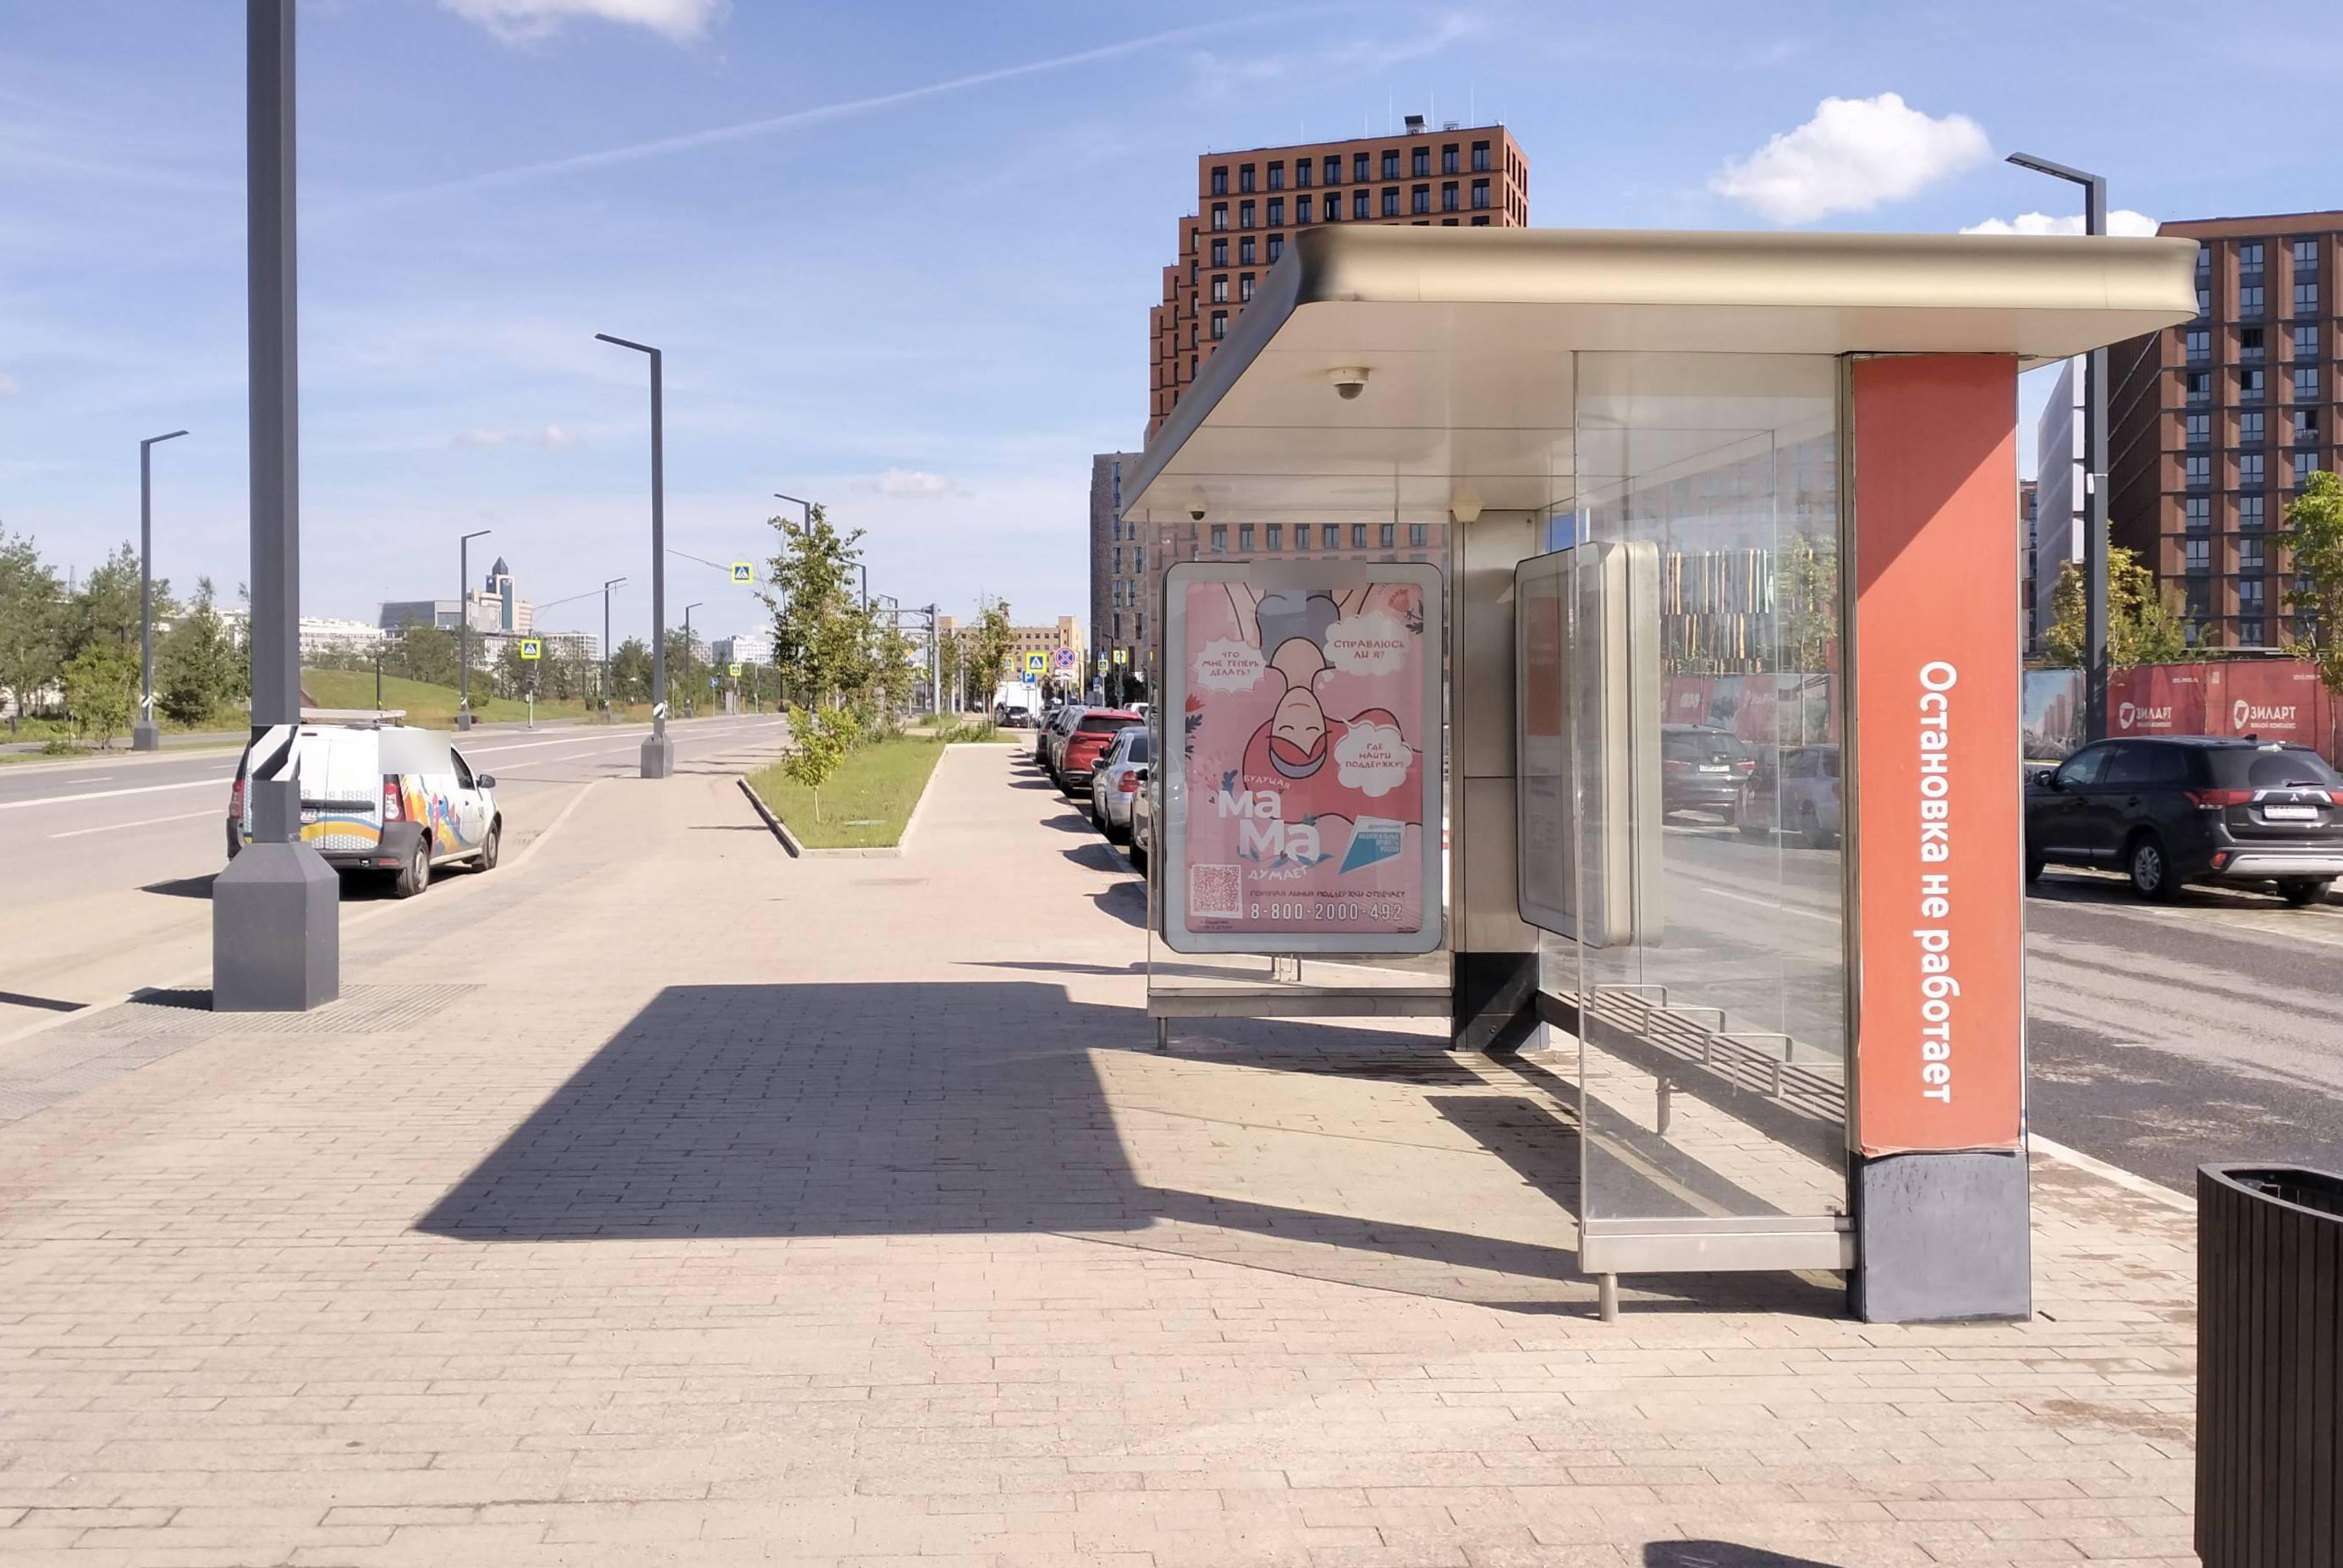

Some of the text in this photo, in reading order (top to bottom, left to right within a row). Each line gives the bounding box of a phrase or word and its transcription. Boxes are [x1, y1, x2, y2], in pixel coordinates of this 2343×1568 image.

[1334, 640, 1405, 649] СПРАВЛЮСЬ
[1354, 651, 1386, 659] ЛИ Я?
[1202, 659, 1259, 668] МНЕ ТЕПЕРЬ
[1209, 668, 1251, 677] ДЕЛАТЬ?
[2136, 706, 2172, 719] ЗИЛАРТ
[2251, 706, 2296, 720] ЗИЛАРТ
[1244, 775, 1291, 790] БУДУЩАЯ
[1248, 865, 1307, 881] ДУМАЕТ
[1913, 661, 1961, 1104] Остановка не работает
[1250, 902, 1403, 922] 8-800-2000-492
